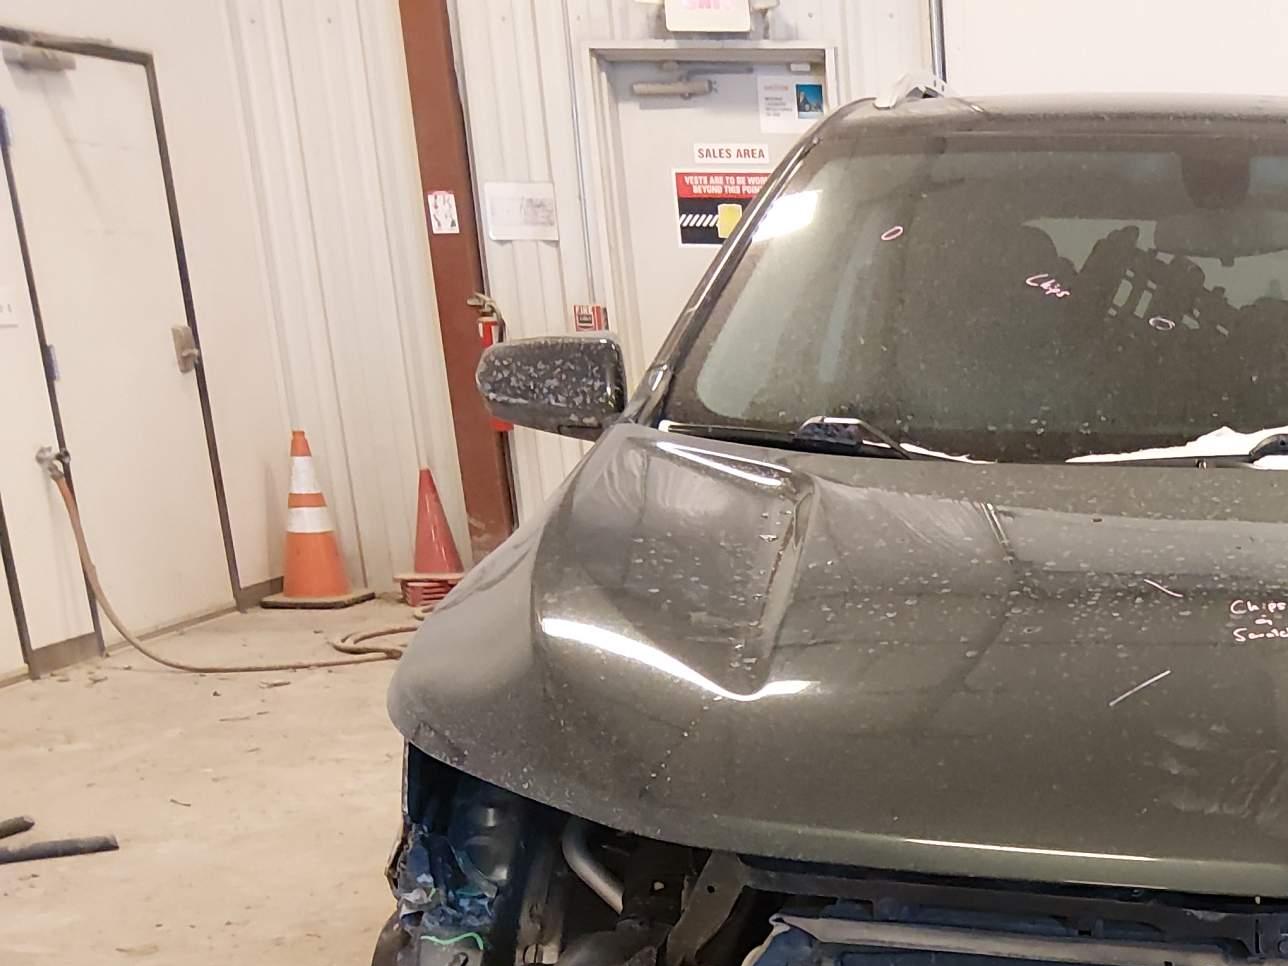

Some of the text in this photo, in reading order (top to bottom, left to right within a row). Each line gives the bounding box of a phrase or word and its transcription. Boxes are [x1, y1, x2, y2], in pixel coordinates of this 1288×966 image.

[697, 148, 765, 159] SALES AREA
[725, 175, 735, 185] TO
